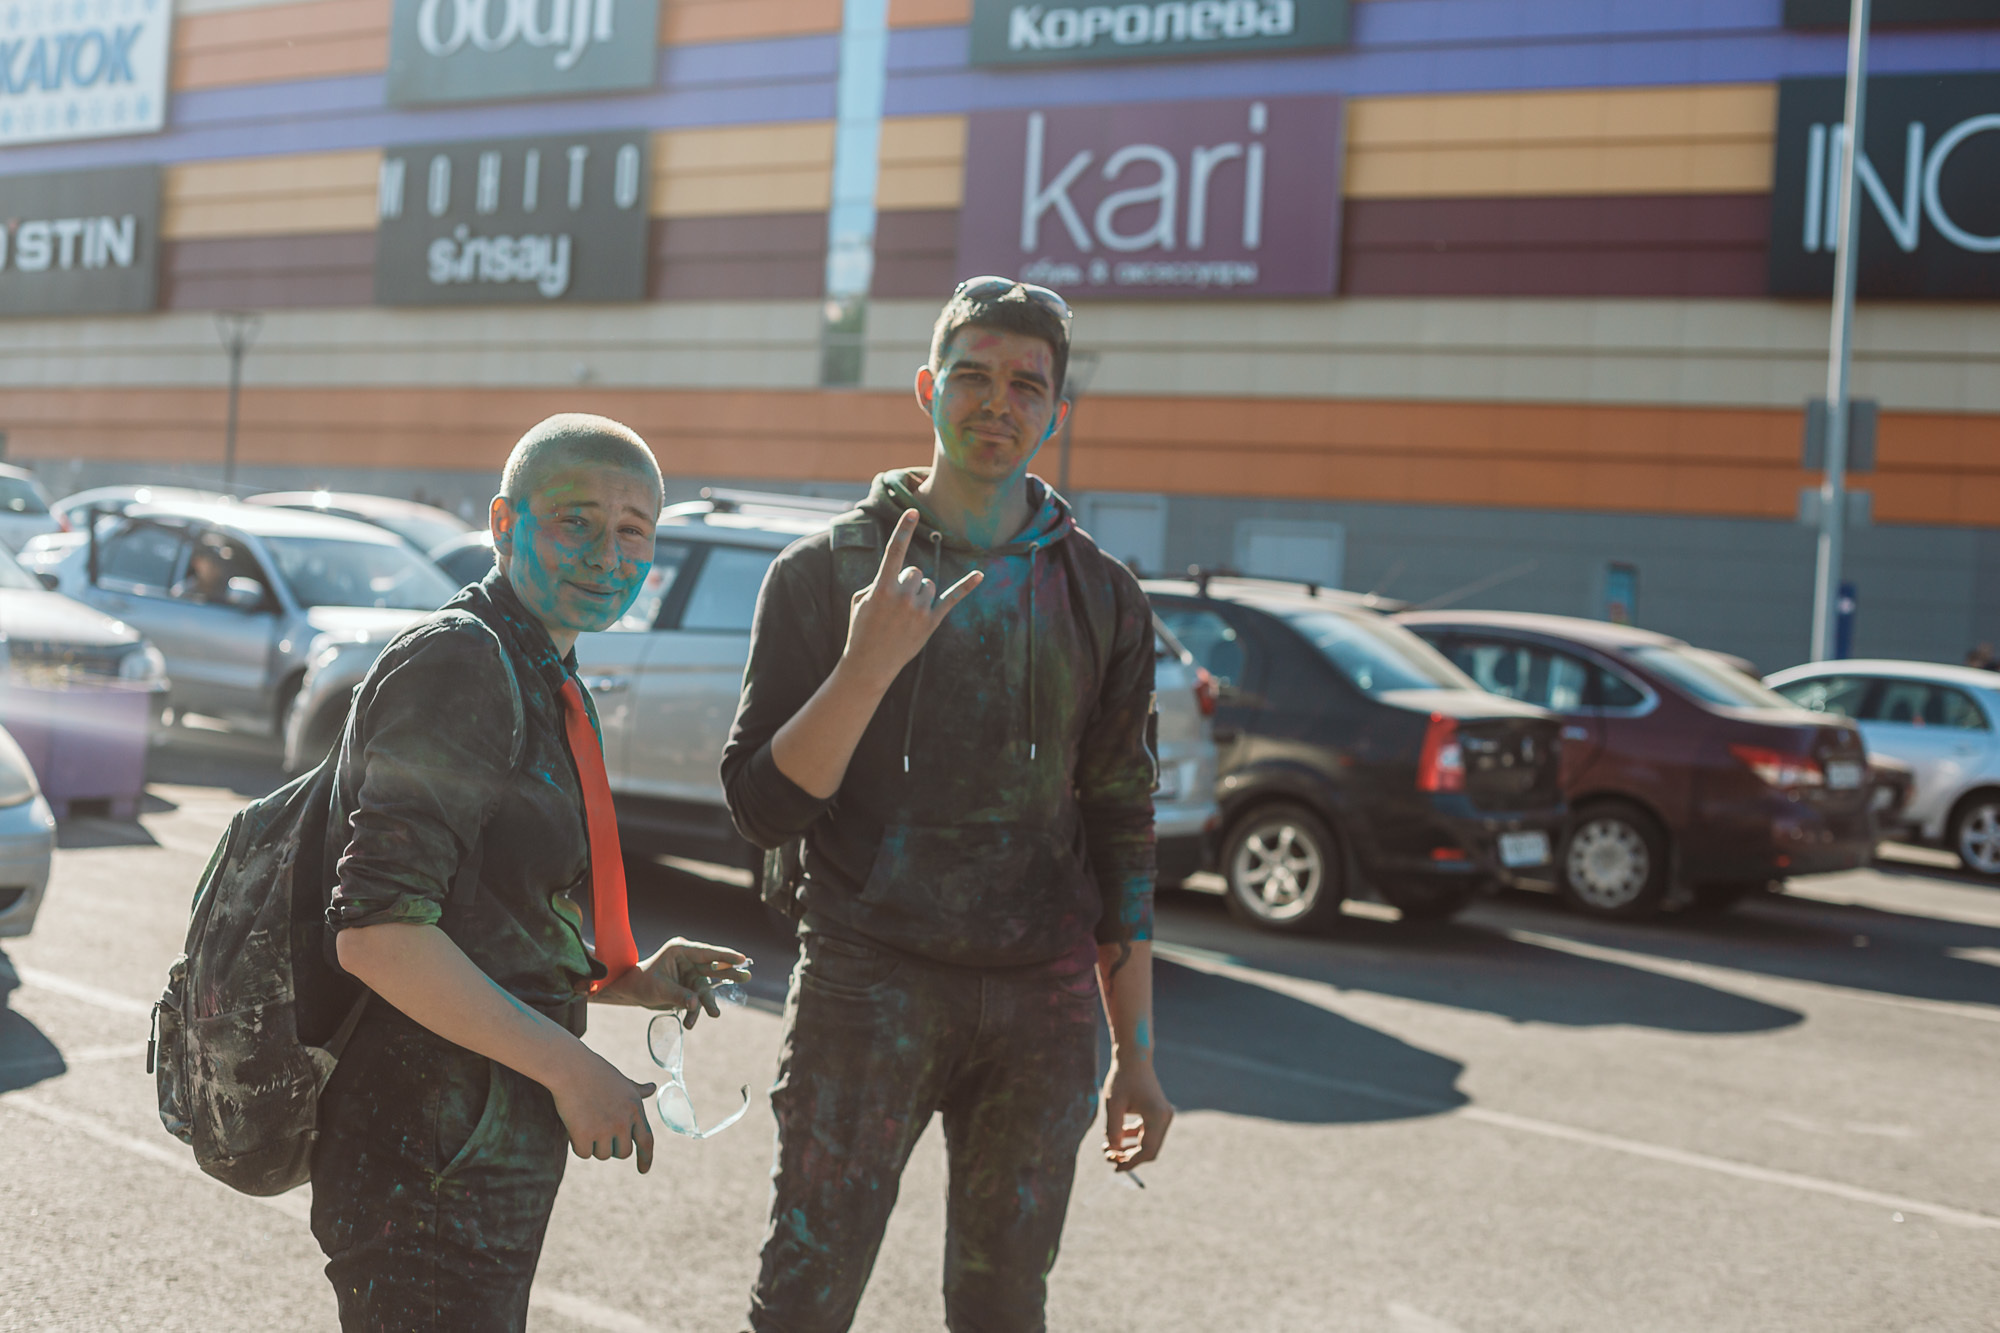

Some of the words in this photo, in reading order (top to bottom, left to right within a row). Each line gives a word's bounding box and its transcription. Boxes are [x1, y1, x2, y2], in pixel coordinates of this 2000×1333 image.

[379, 144, 639, 219] MOHITO
[1019, 102, 1267, 251] kari
[0, 214, 136, 273] 'STIN
